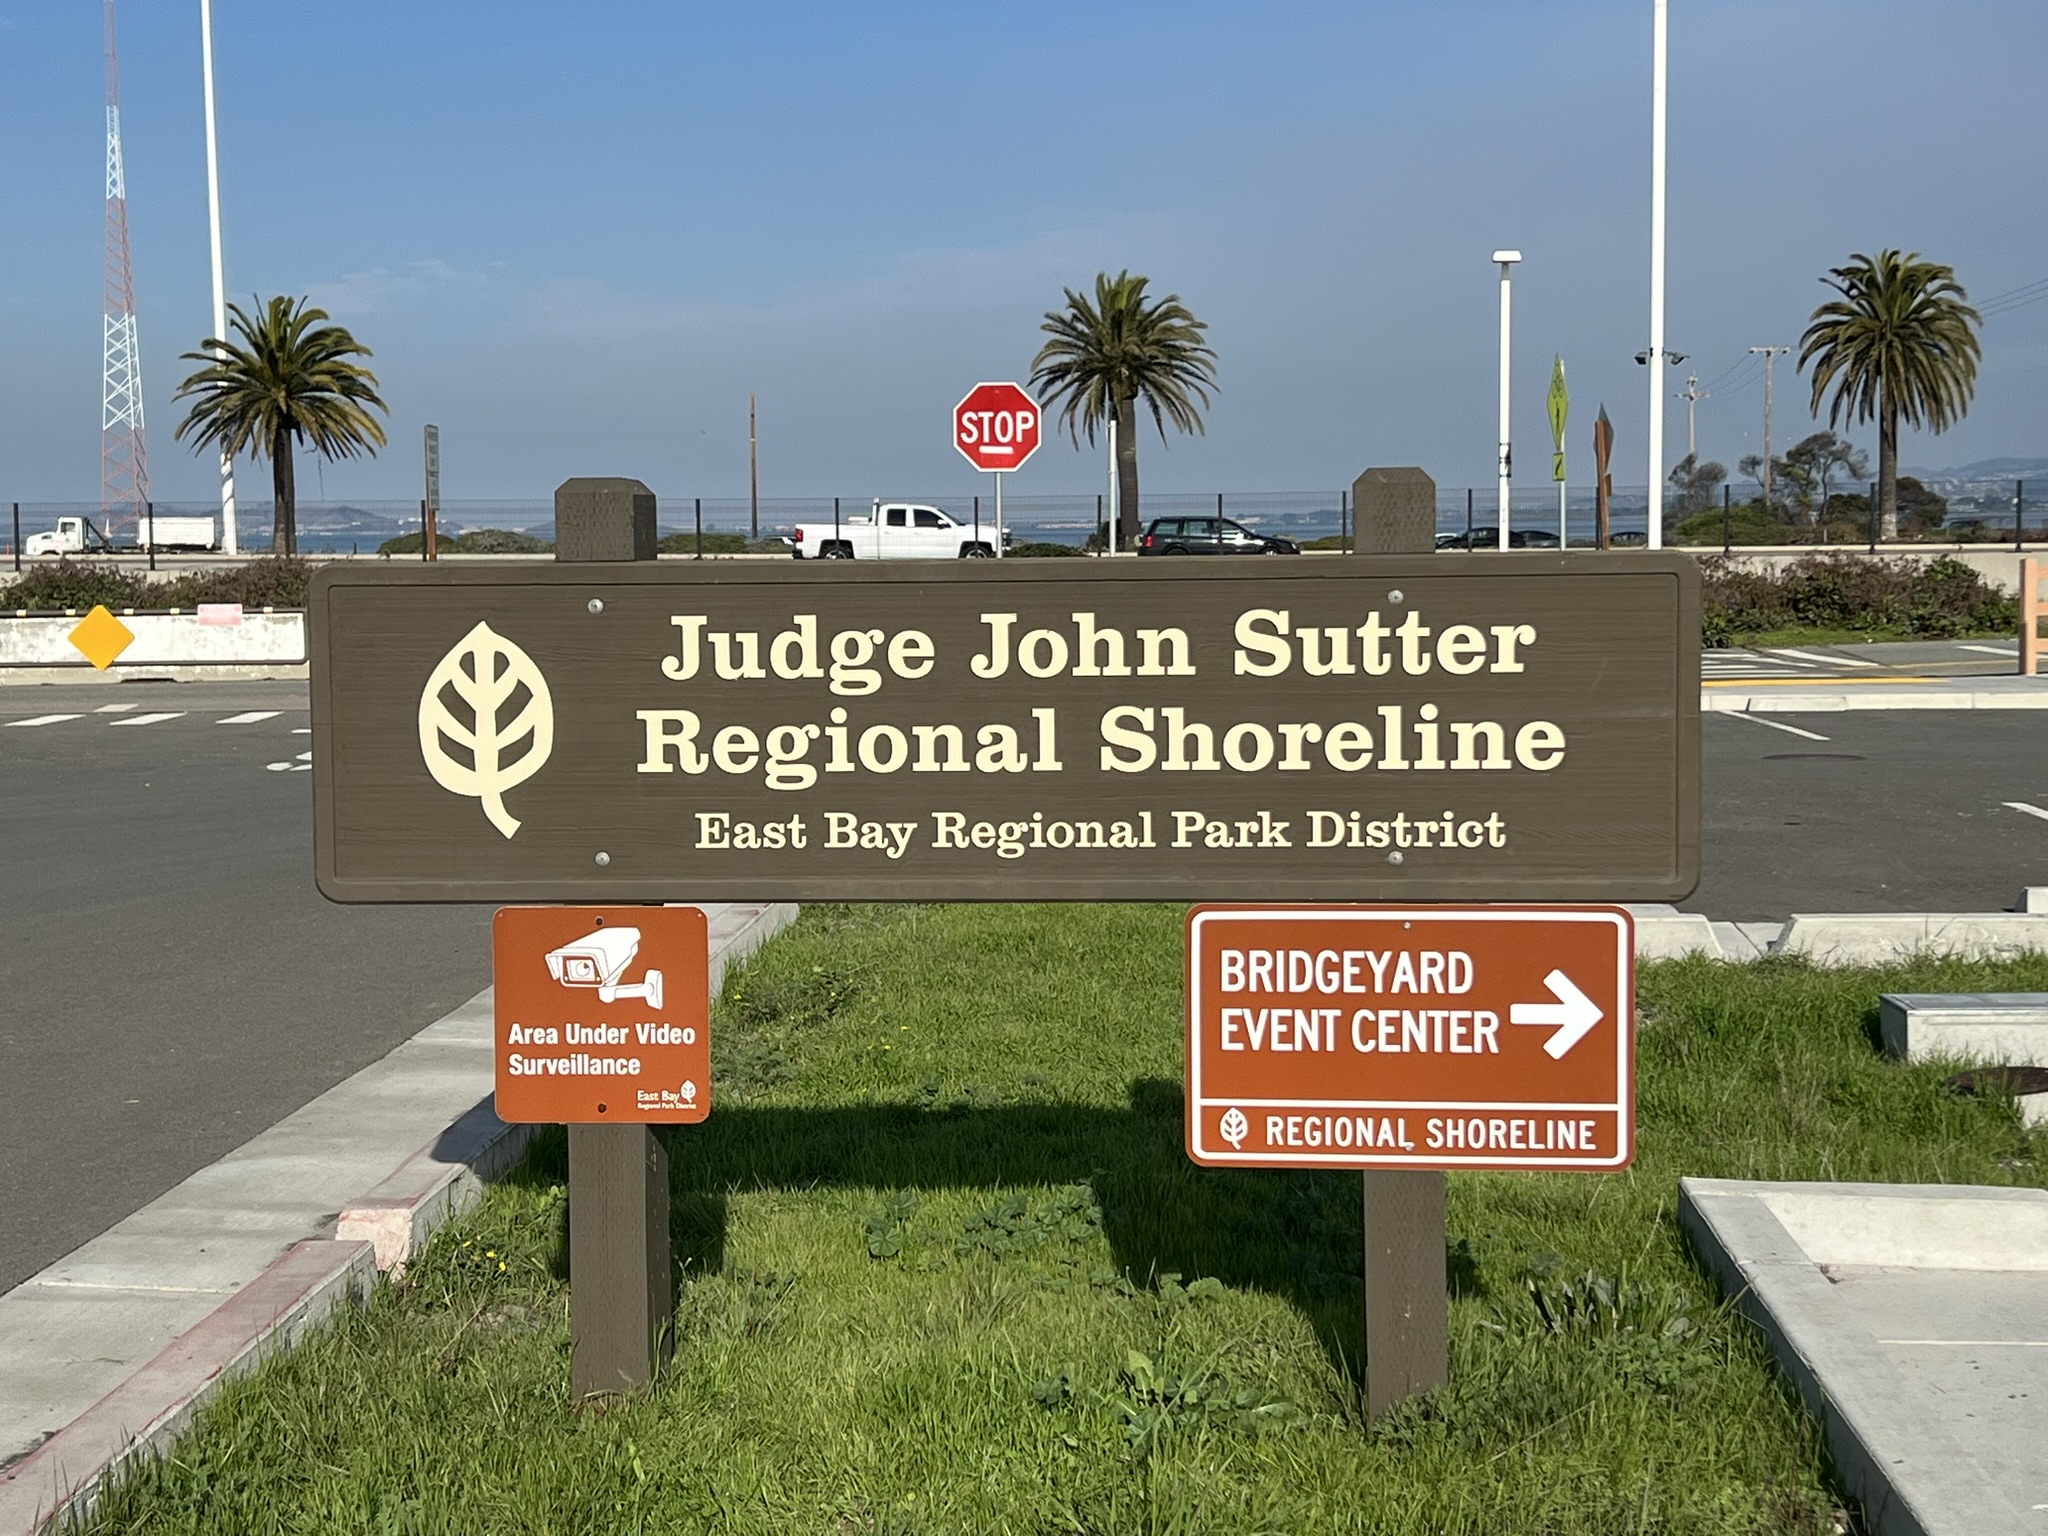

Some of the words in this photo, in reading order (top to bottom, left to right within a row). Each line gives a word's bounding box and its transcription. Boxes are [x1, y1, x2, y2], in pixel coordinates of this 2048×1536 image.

[960, 410, 1035, 444] STOP
[661, 614, 935, 696] Judge
[970, 612, 1197, 679] John
[1234, 608, 1537, 677] Sutter
[636, 706, 1063, 791] Regional
[1100, 703, 1566, 773] Shoreline
[694, 812, 807, 849] East
[823, 812, 918, 859] Bay
[931, 811, 1157, 859] Regional
[1170, 810, 1293, 848] Park
[1305, 810, 1507, 848] District
[1220, 949, 1474, 994] BRIDGEYARD
[508, 1023, 559, 1045] Area
[565, 1023, 630, 1045] Under
[635, 1022, 696, 1045] Video
[1220, 1007, 1342, 1052] EVENT
[1351, 1008, 1500, 1054] CENTER
[508, 1053, 641, 1076] Surveillance
[637, 1089, 660, 1102] East
[661, 1089, 681, 1104] Bay
[1266, 1115, 1415, 1149] REGIONAL
[1425, 1117, 1597, 1151] SHORELINE
